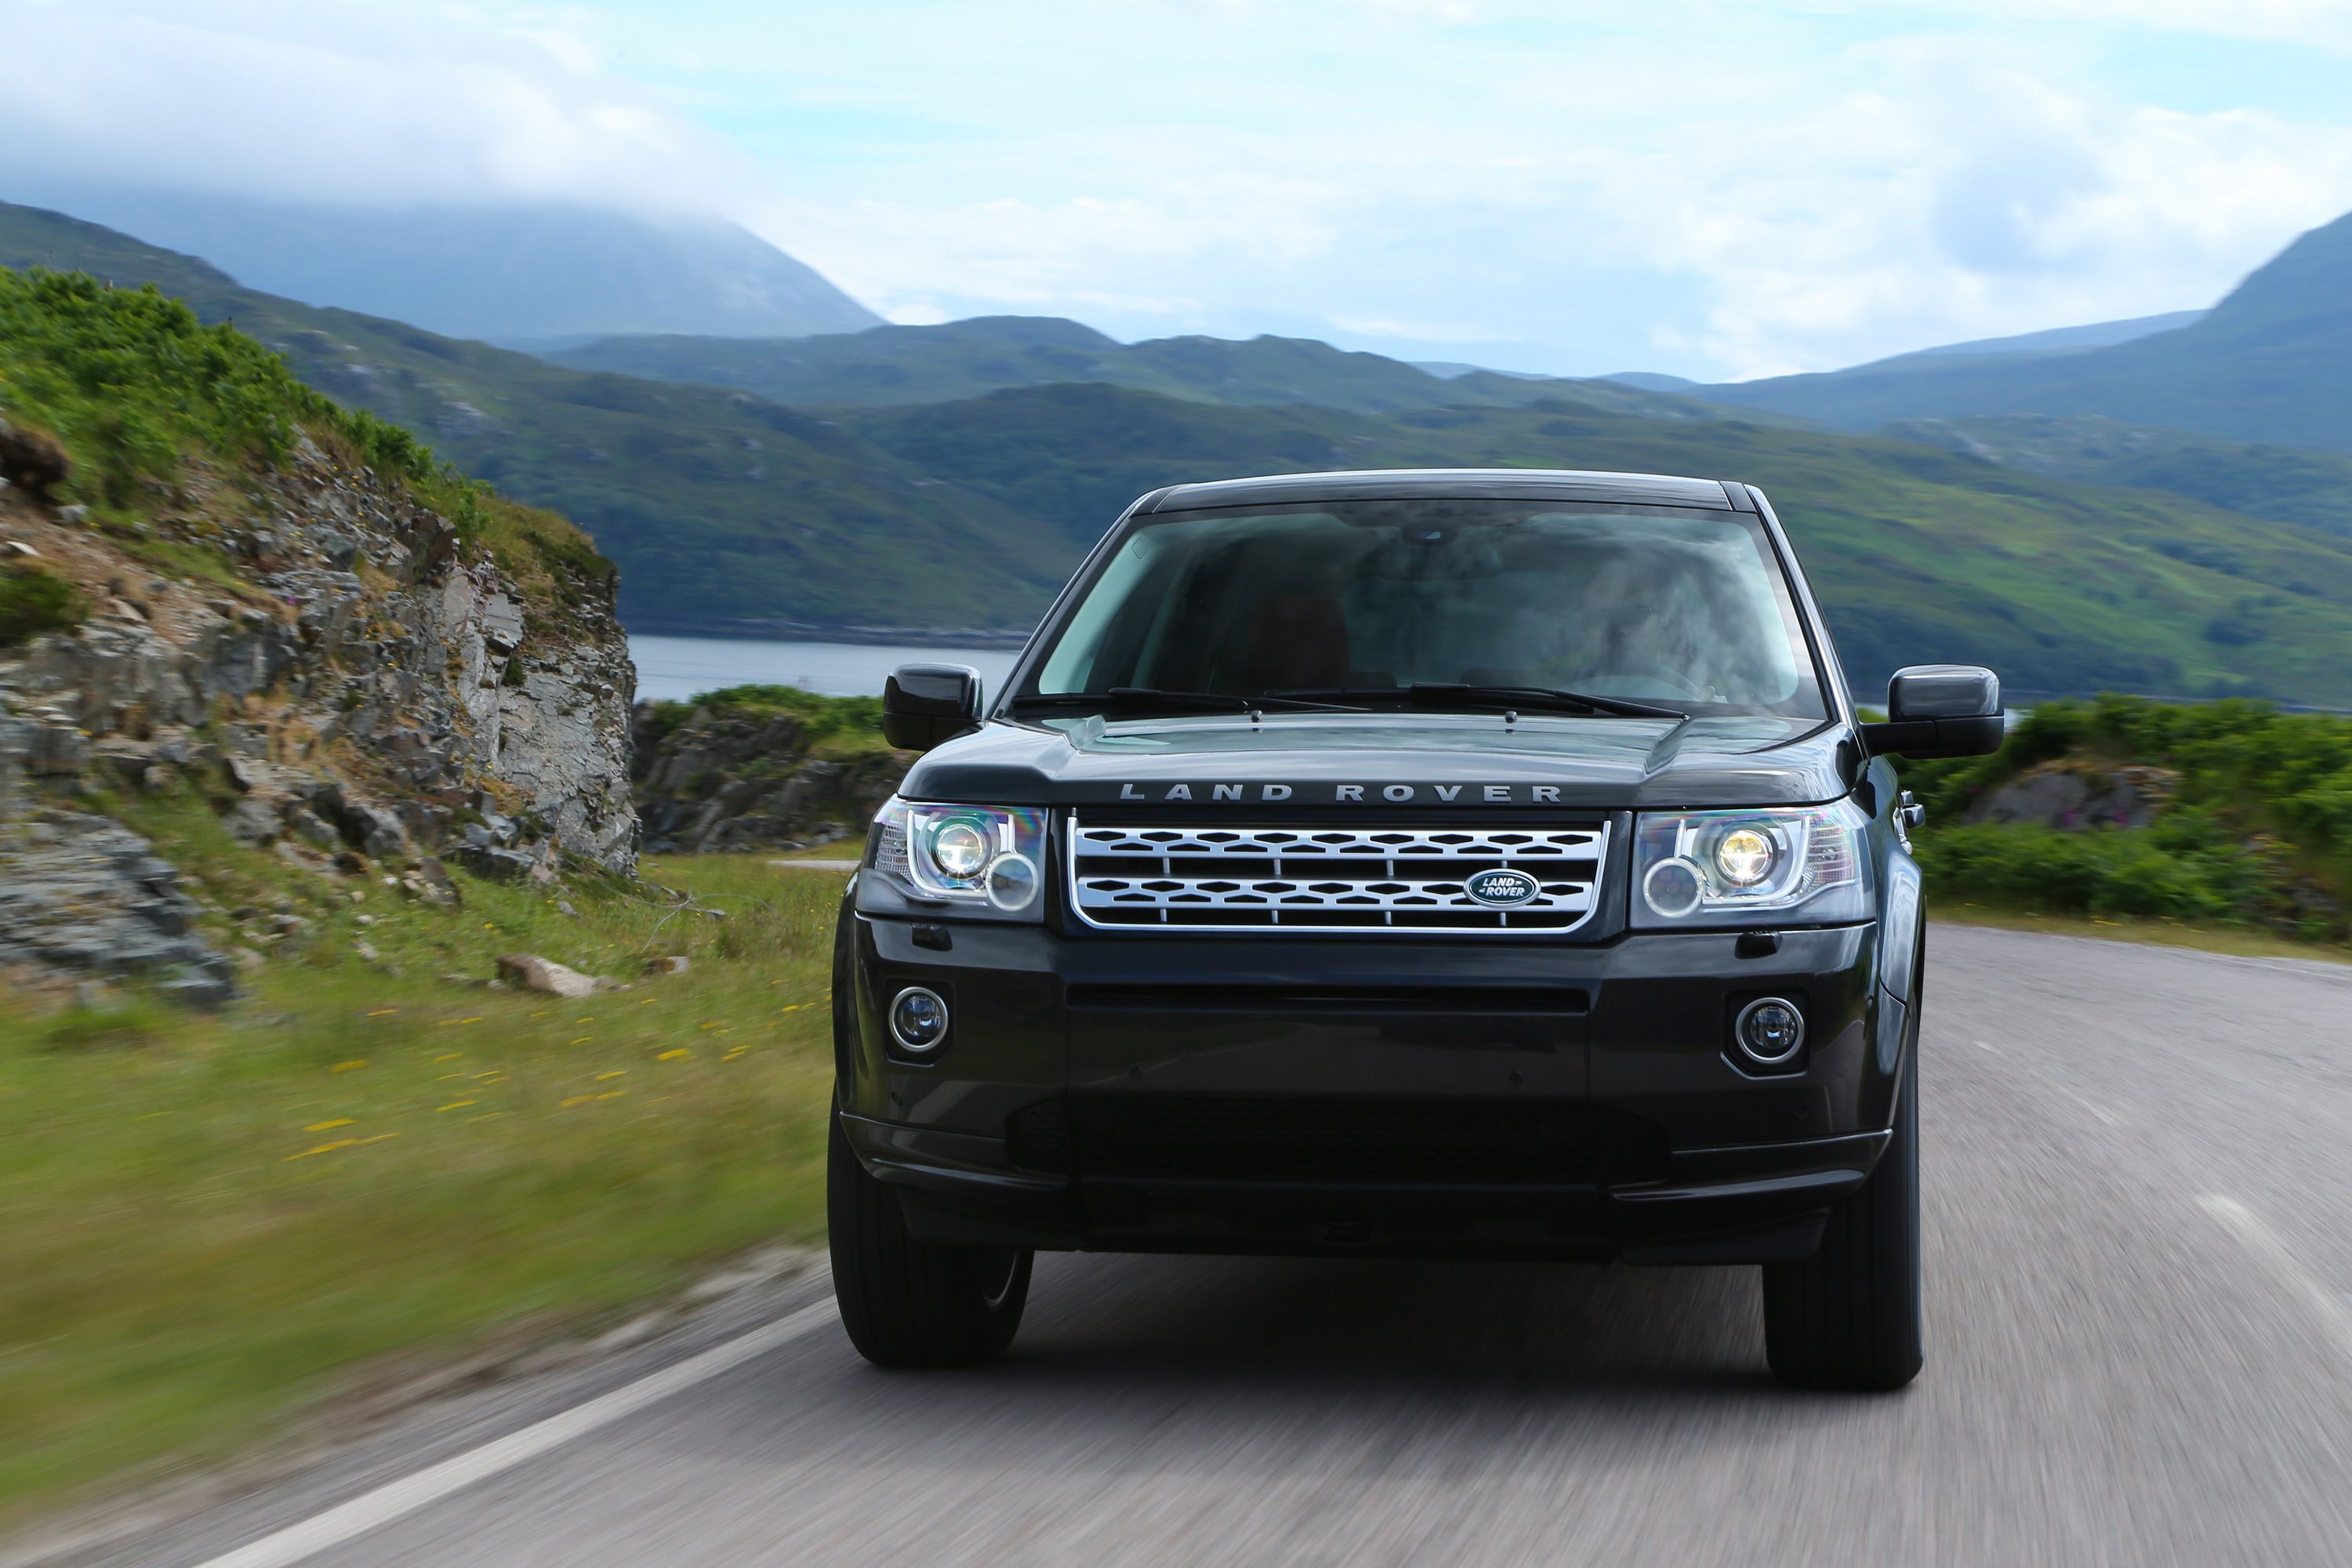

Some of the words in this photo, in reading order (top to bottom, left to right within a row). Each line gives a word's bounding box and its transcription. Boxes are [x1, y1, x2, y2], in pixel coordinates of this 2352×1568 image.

[1120, 784, 1292, 800] LAND
[1335, 785, 1561, 802] ROVER
[1483, 877, 1515, 887] LAND
[1486, 887, 1525, 896] ROVER
